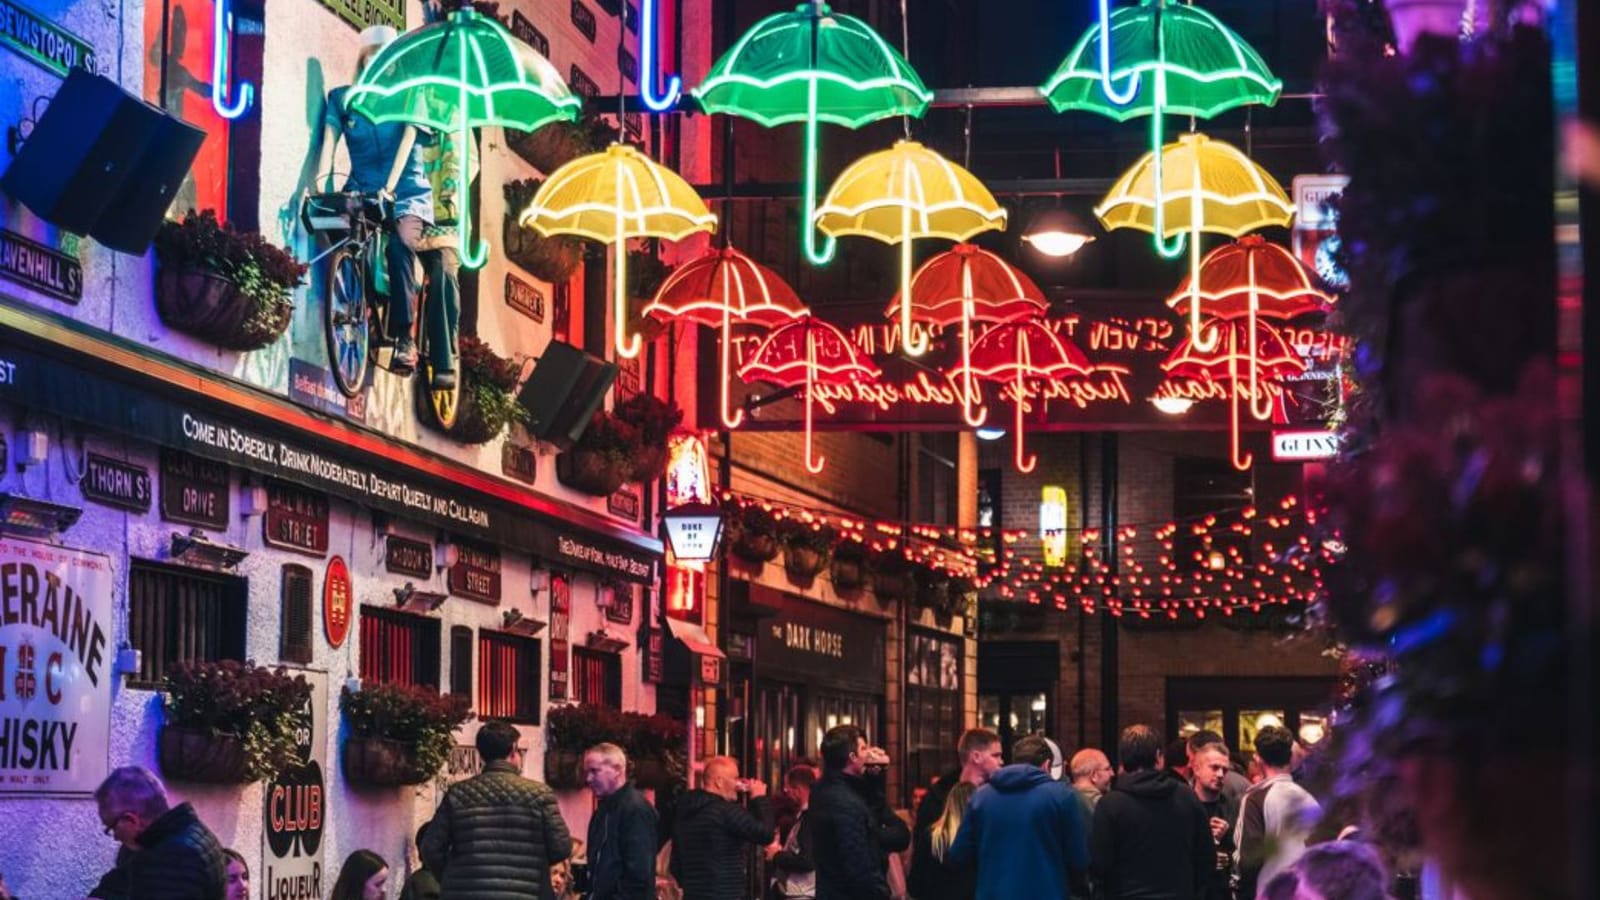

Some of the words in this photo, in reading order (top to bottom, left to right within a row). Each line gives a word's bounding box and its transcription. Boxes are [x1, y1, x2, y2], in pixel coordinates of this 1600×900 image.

[1281, 435, 1336, 452] GUINN
[90, 463, 132, 499] THORN
[182, 413, 215, 446] COME
[217, 427, 229, 449] IN
[230, 428, 278, 464] SOBERLY,
[280, 443, 310, 472] DRINK
[310, 454, 369, 495] MODERATELY,
[370, 473, 401, 501] DEPART
[402, 484, 432, 511] QUIETLY
[449, 499, 469, 522] CALL
[468, 506, 489, 528] AGAIN
[184, 487, 216, 517] DRIVE
[281, 518, 318, 548] STREET
[466, 571, 491, 595] STREET
[0, 562, 106, 688] ERAINE
[786, 622, 810, 652] DARK
[814, 628, 843, 659] HORSE
[0, 717, 78, 770] HISKY
[270, 784, 321, 833] CLUB
[268, 861, 321, 900] LIQUEUR
